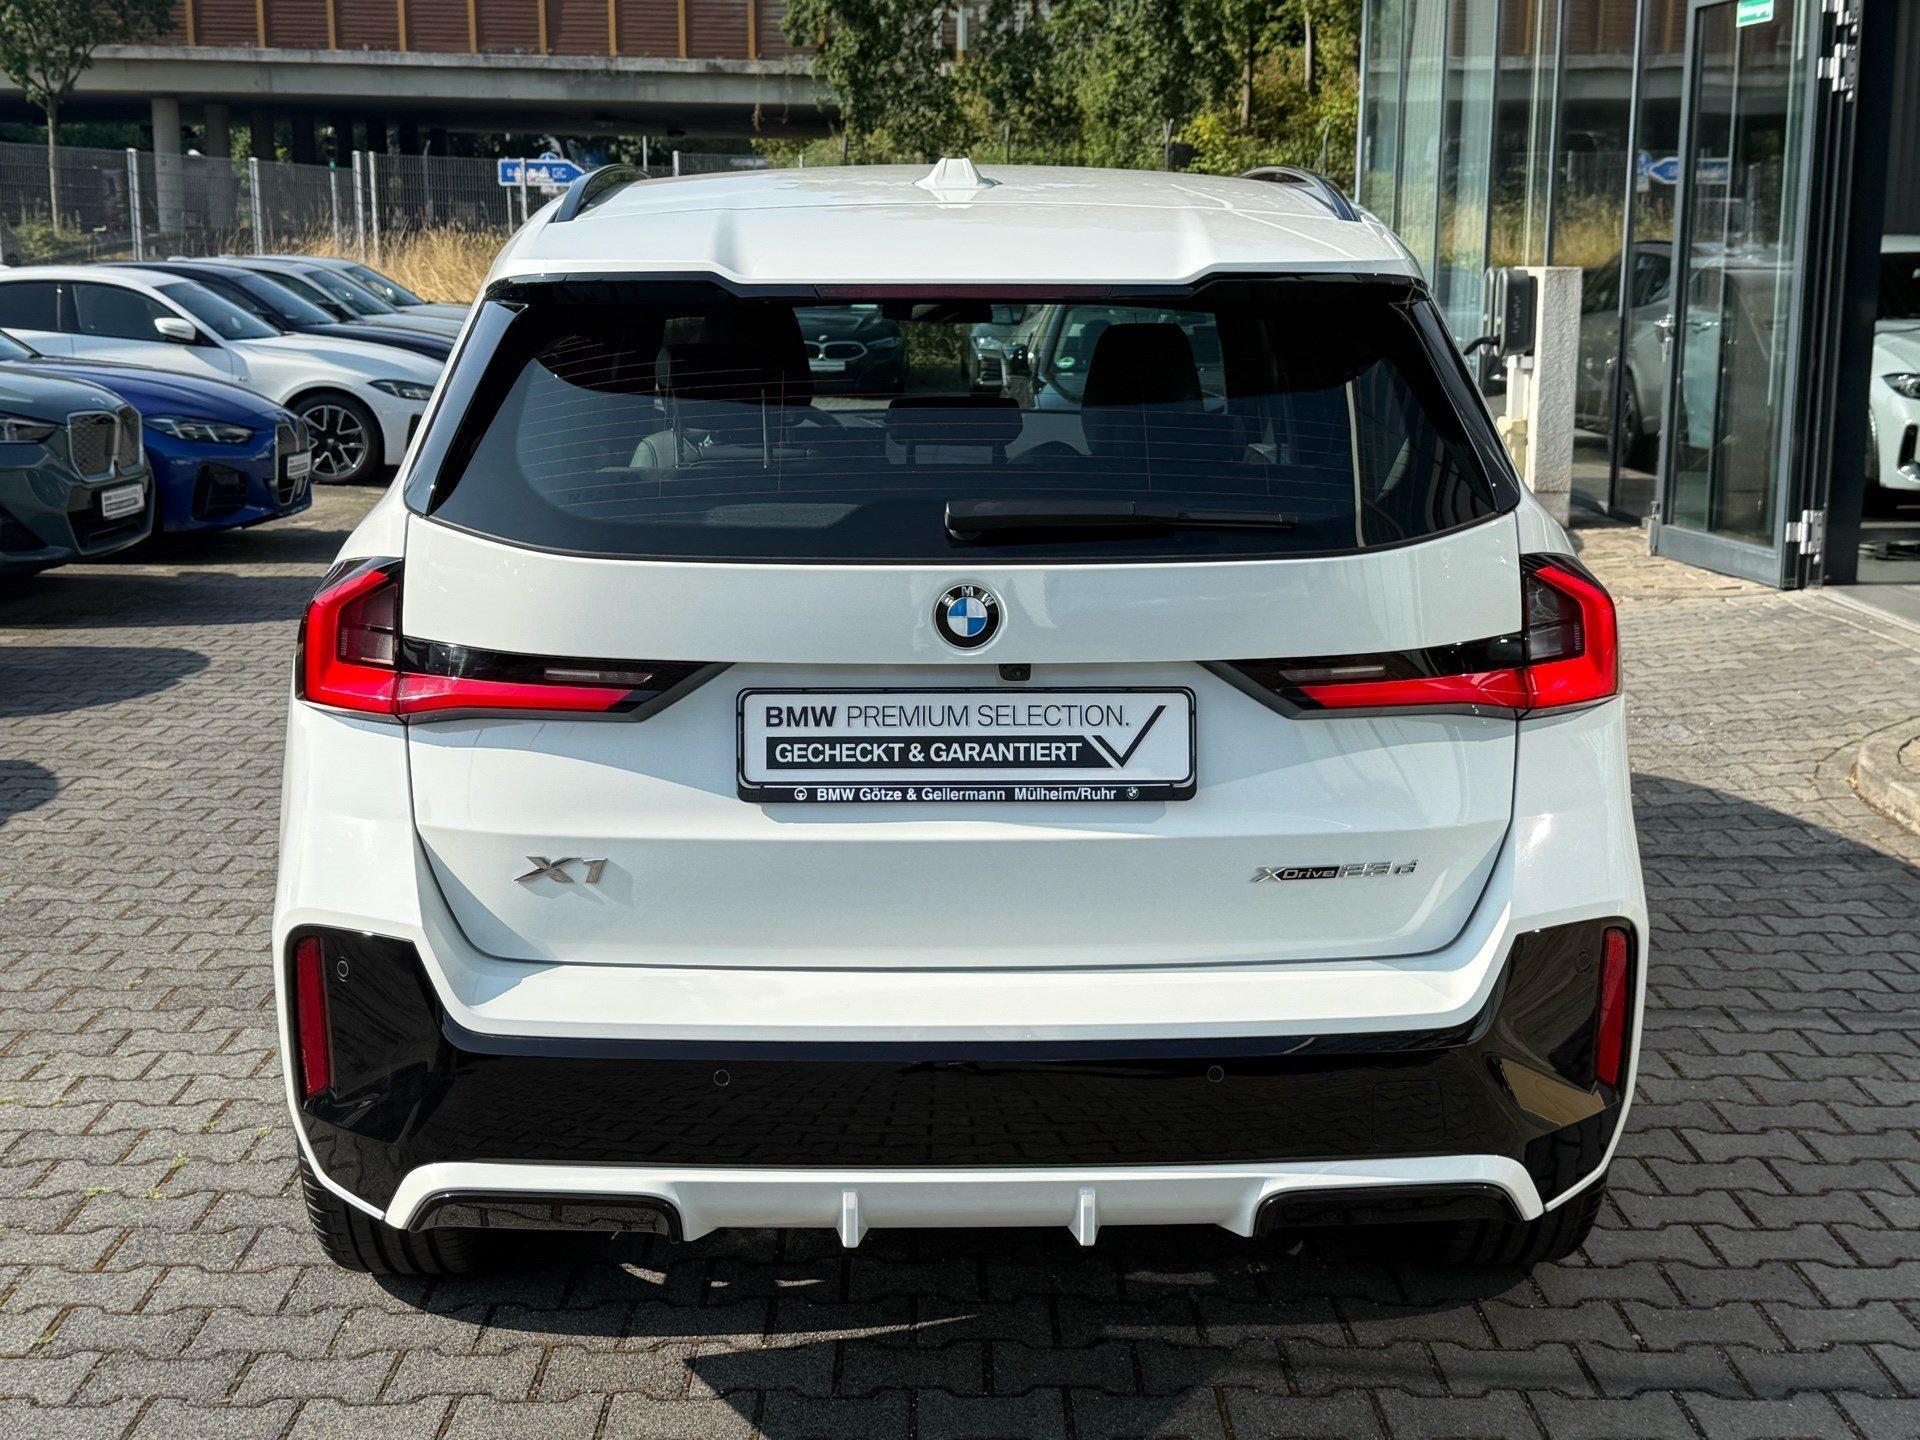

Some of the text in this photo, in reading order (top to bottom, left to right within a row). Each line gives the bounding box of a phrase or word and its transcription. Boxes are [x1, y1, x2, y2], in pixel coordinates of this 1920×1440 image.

[765, 704, 1130, 727] BMW PREMIUM SELECTION.
[775, 742, 1082, 762] GECHECKT & GARANTIERT
[817, 787, 1116, 801] BMW Götze & Gellermann Mülheim/Ruhr
[513, 856, 608, 883] X1
